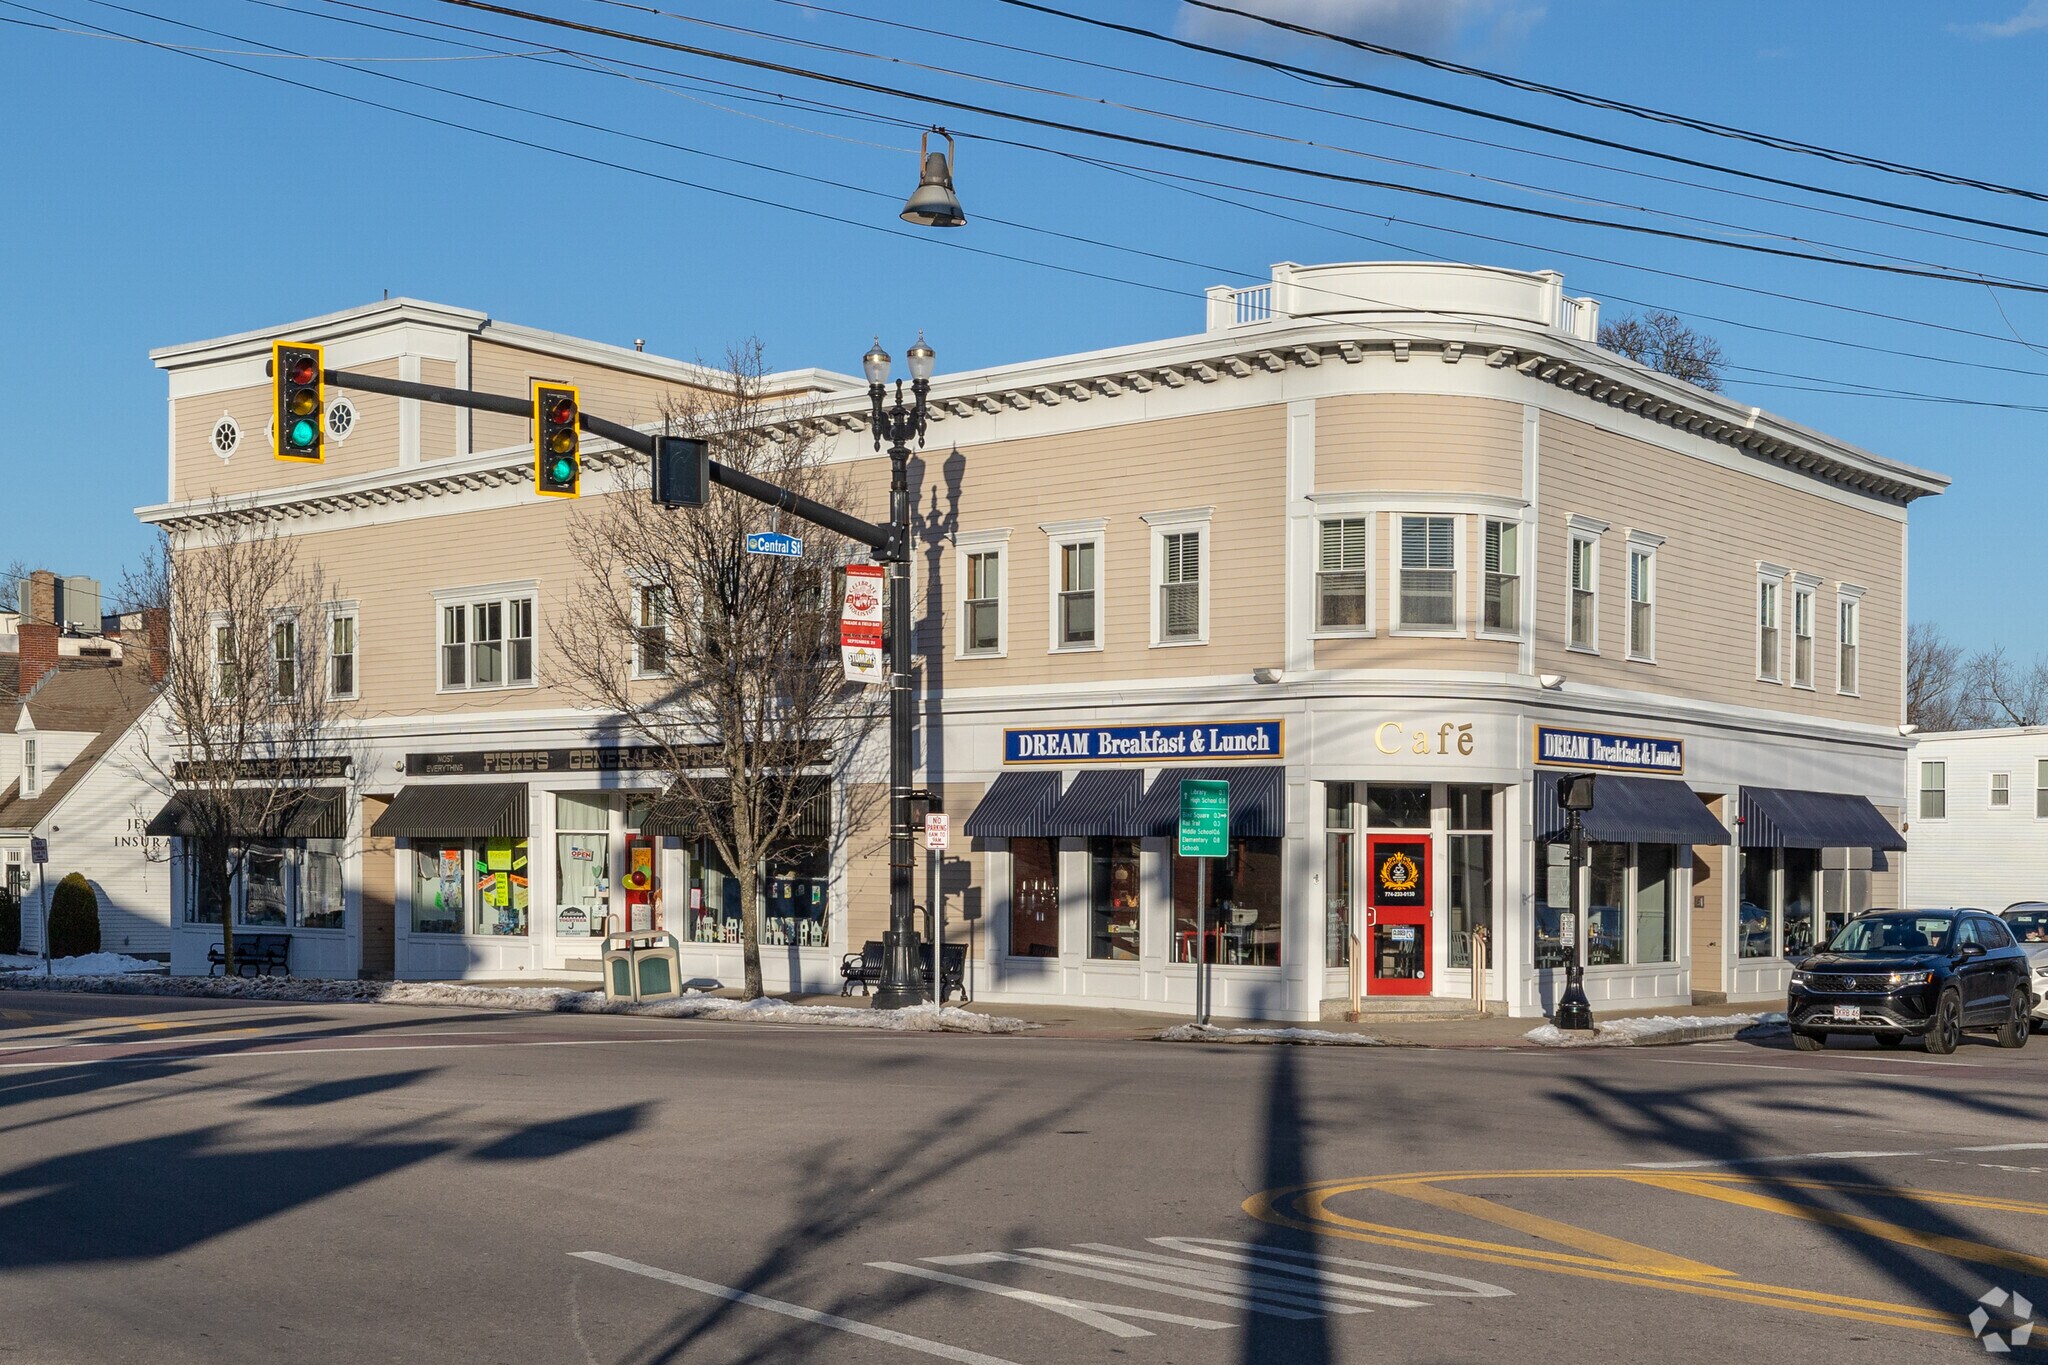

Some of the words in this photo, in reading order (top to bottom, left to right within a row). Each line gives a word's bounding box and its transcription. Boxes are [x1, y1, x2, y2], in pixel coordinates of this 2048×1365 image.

[758, 537, 789, 553] Central
[791, 541, 801, 554] St
[848, 604, 876, 616] HOLLISTON
[1018, 732, 1090, 757] DREAM
[1098, 729, 1186, 755] Breakfast
[1190, 728, 1205, 753] &
[1209, 727, 1270, 753] Lunch
[1544, 733, 1590, 760] DREAM
[1592, 738, 1641, 764] Breakfast
[1641, 742, 1651, 765] &
[1651, 743, 1681, 767] Lunch
[437, 755, 454, 763] MOST
[483, 751, 549, 772] FISKE'S
[569, 748, 652, 770] GENERAL
[426, 763, 464, 773] EVERYTHING
[1182, 836, 1208, 844] Elementary
[571, 850, 591, 858] OPEN
